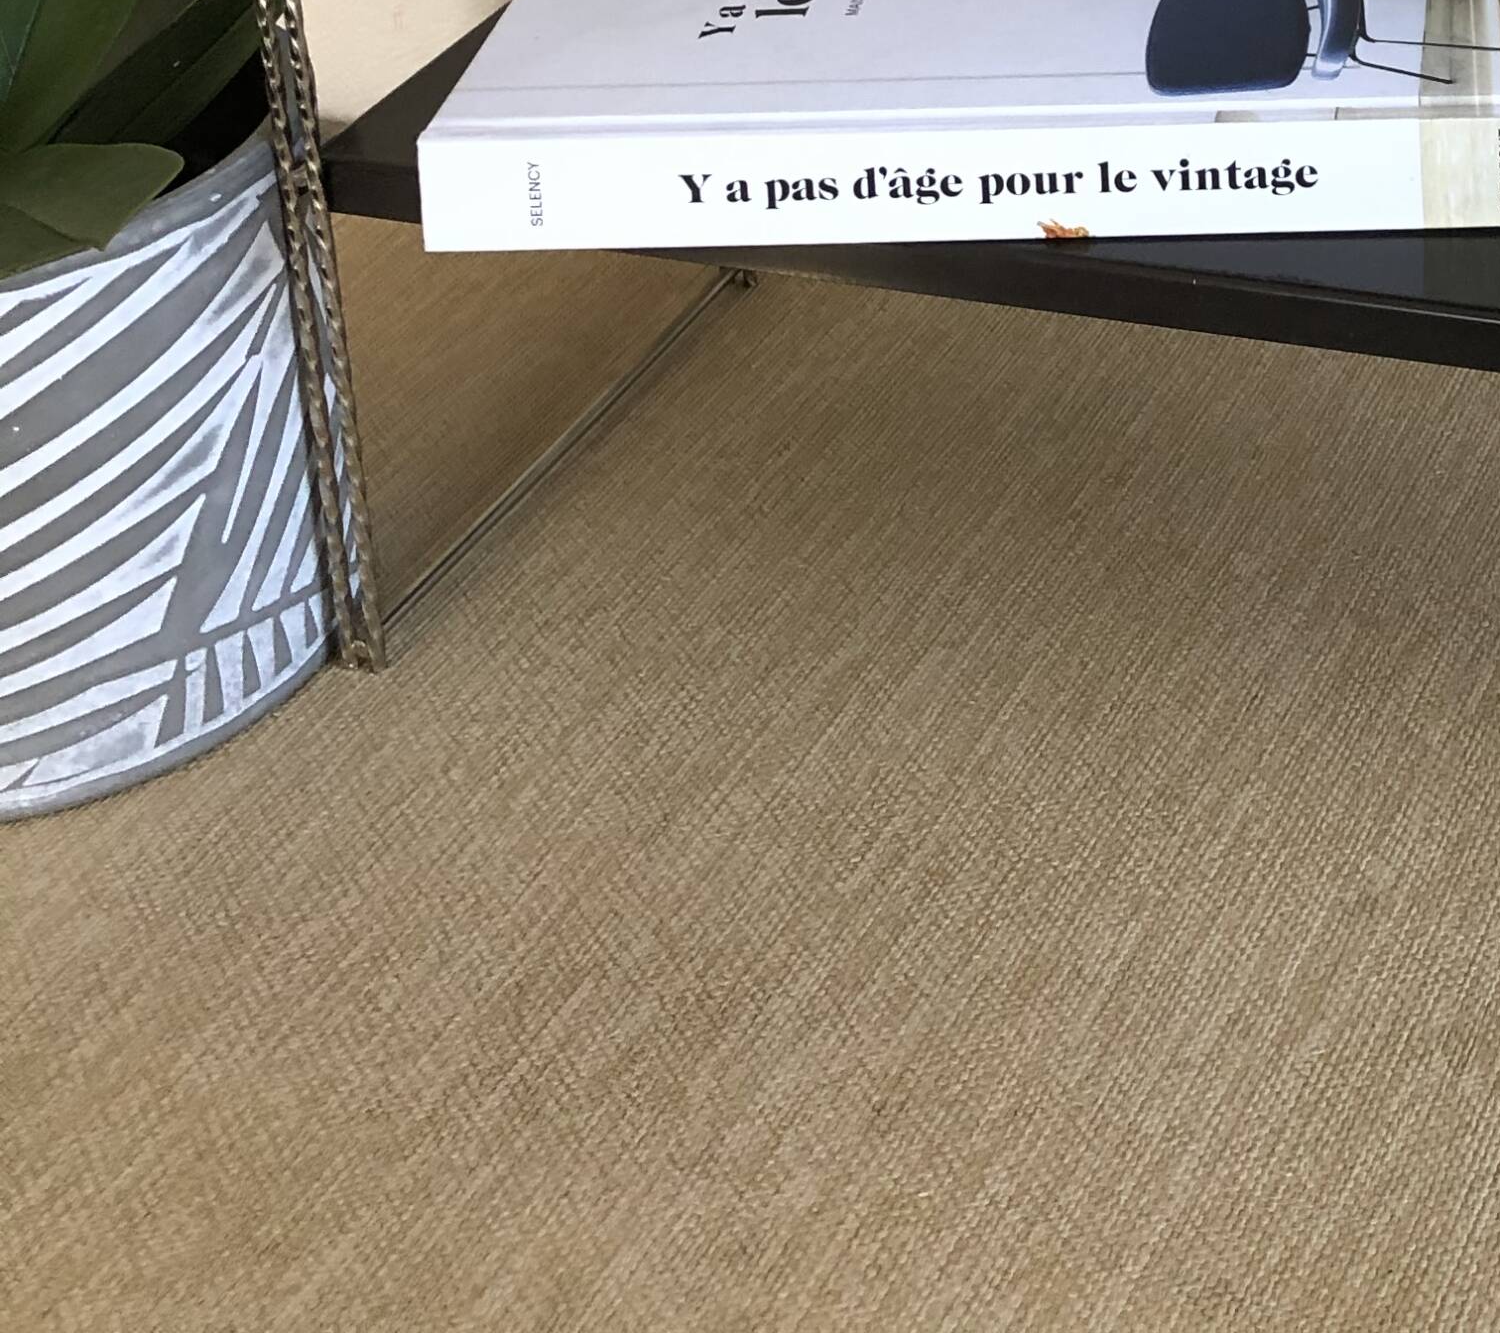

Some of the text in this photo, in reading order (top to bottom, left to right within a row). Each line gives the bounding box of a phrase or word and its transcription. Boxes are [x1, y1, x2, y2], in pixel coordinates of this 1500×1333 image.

[698, 21, 736, 39] Y
[719, 4, 746, 18] a
[527, 162, 544, 227] SELENCY
[679, 158, 1318, 210] Y a pas d'âge pour le vintage
